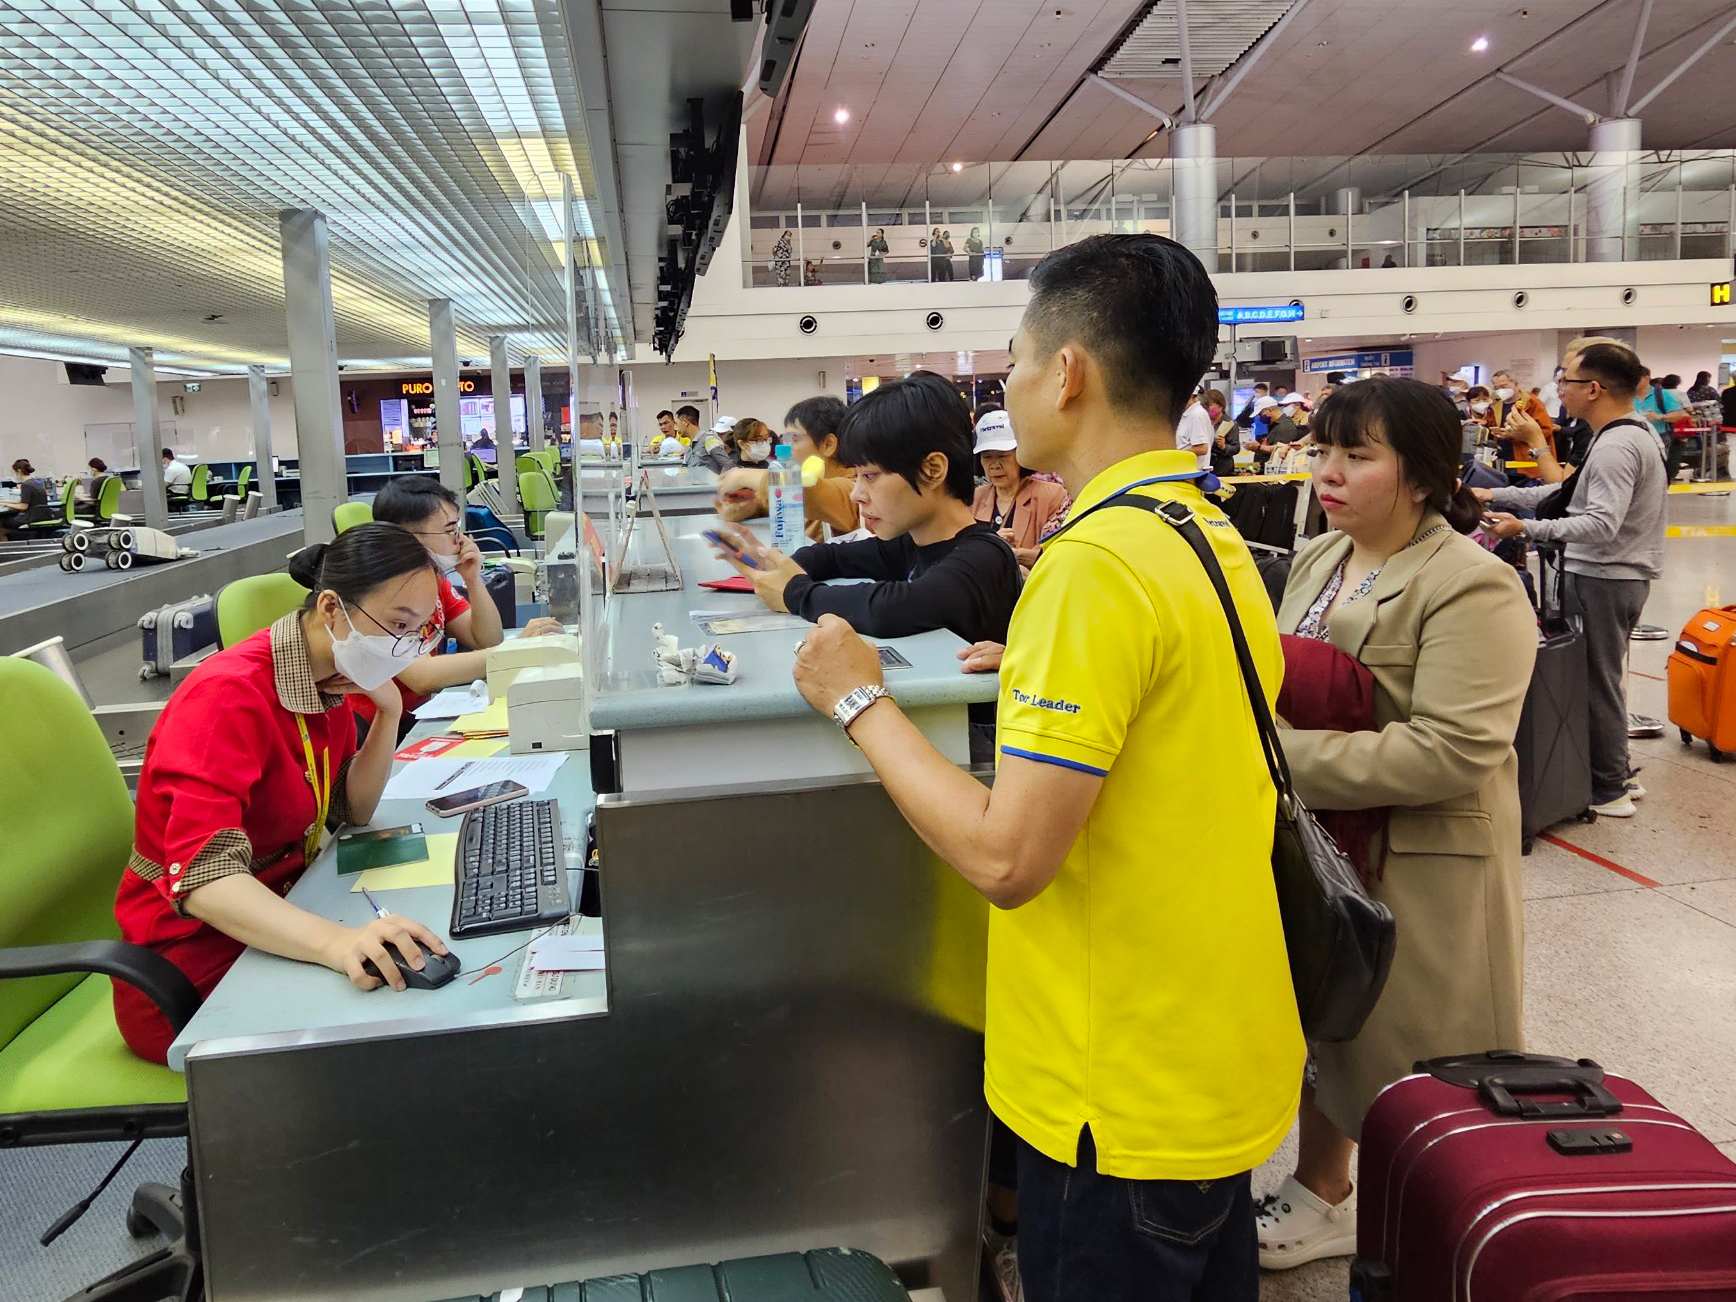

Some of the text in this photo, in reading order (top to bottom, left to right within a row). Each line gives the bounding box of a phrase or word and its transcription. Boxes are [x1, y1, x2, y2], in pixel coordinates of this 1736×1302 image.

[1714, 284, 1730, 303] H
[402, 382, 433, 394] PURO
[1031, 694, 1081, 713] Leader
